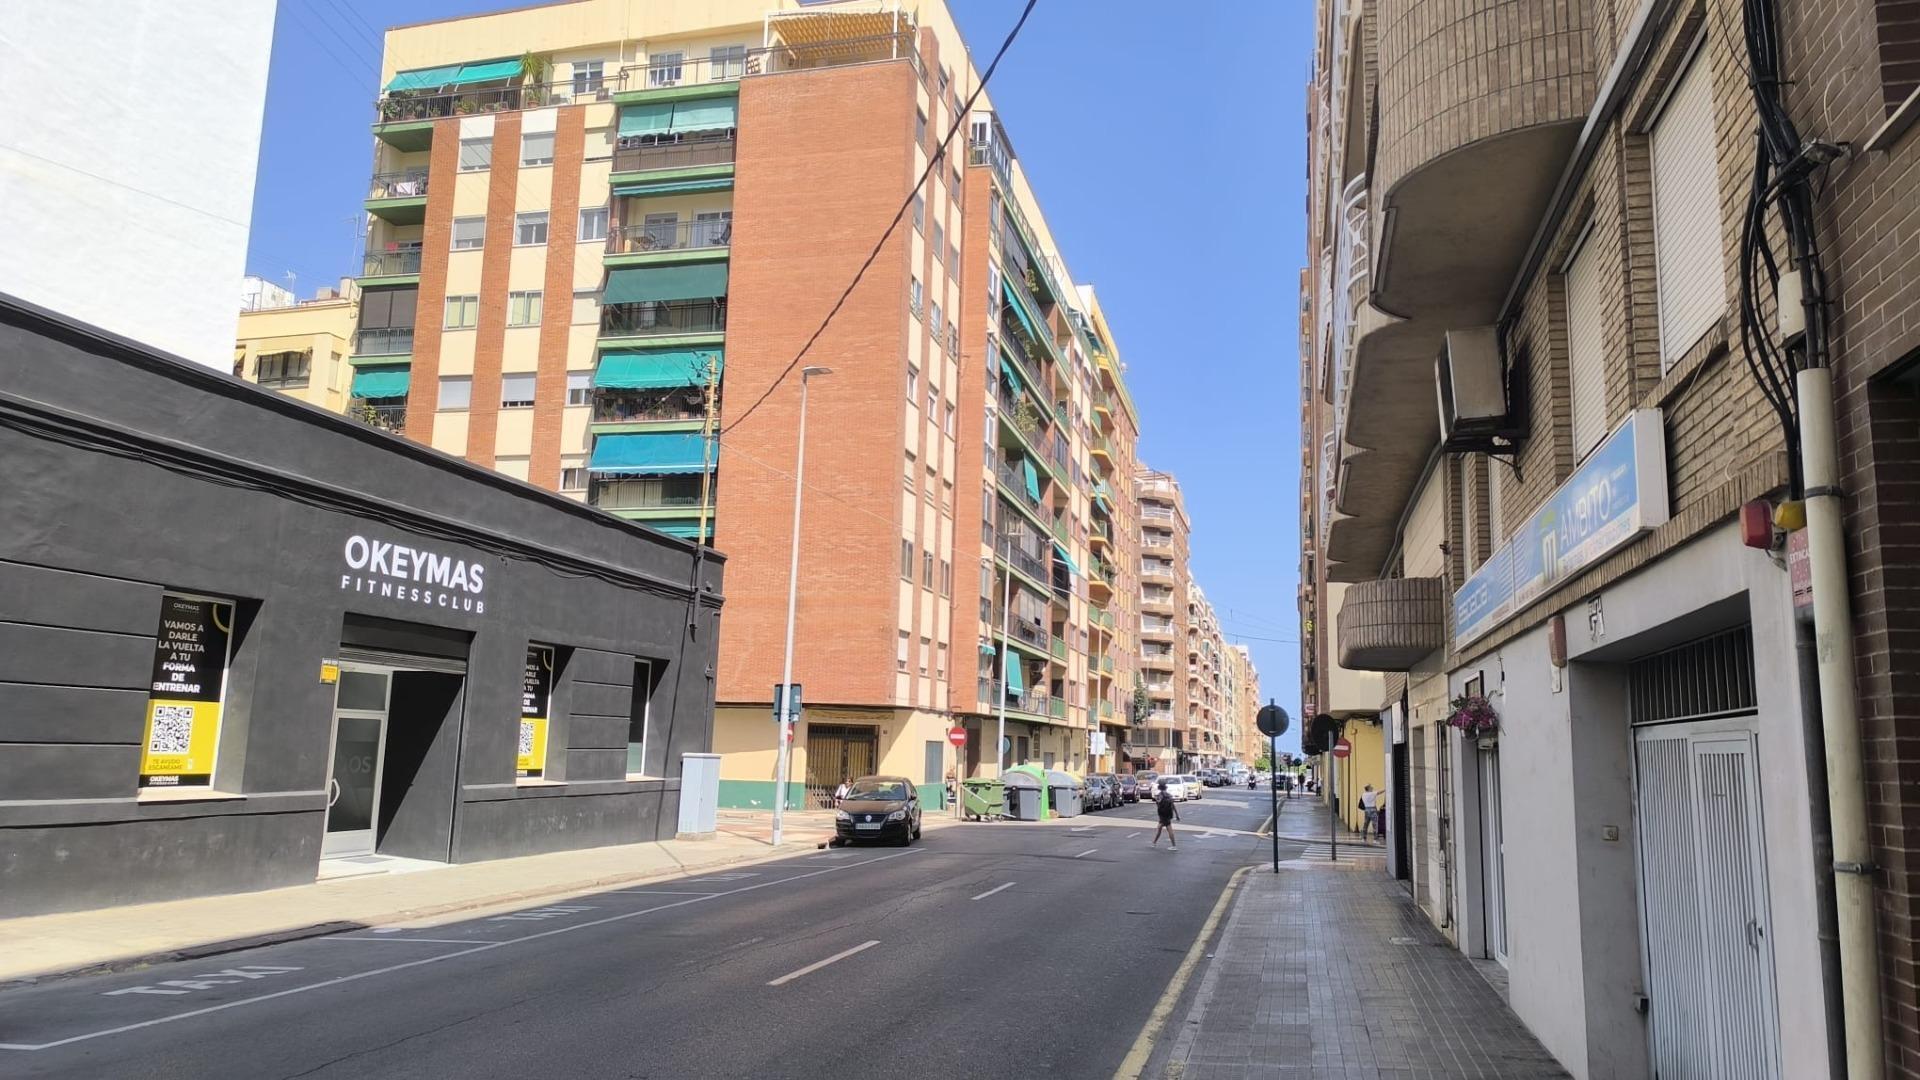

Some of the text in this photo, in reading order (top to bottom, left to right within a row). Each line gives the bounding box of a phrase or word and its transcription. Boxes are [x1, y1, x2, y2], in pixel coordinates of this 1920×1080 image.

[344, 535, 484, 594] OKEYMAS
[164, 619, 204, 632] VAMOS A
[168, 631, 198, 642] DARLE
[158, 640, 205, 653] LA VUELTA
[170, 652, 191, 662] A TU
[162, 661, 196, 673] FORMA
[171, 672, 185, 682] DE
[152, 681, 200, 694] ENTRENAR
[101, 966, 305, 996] TAXI
